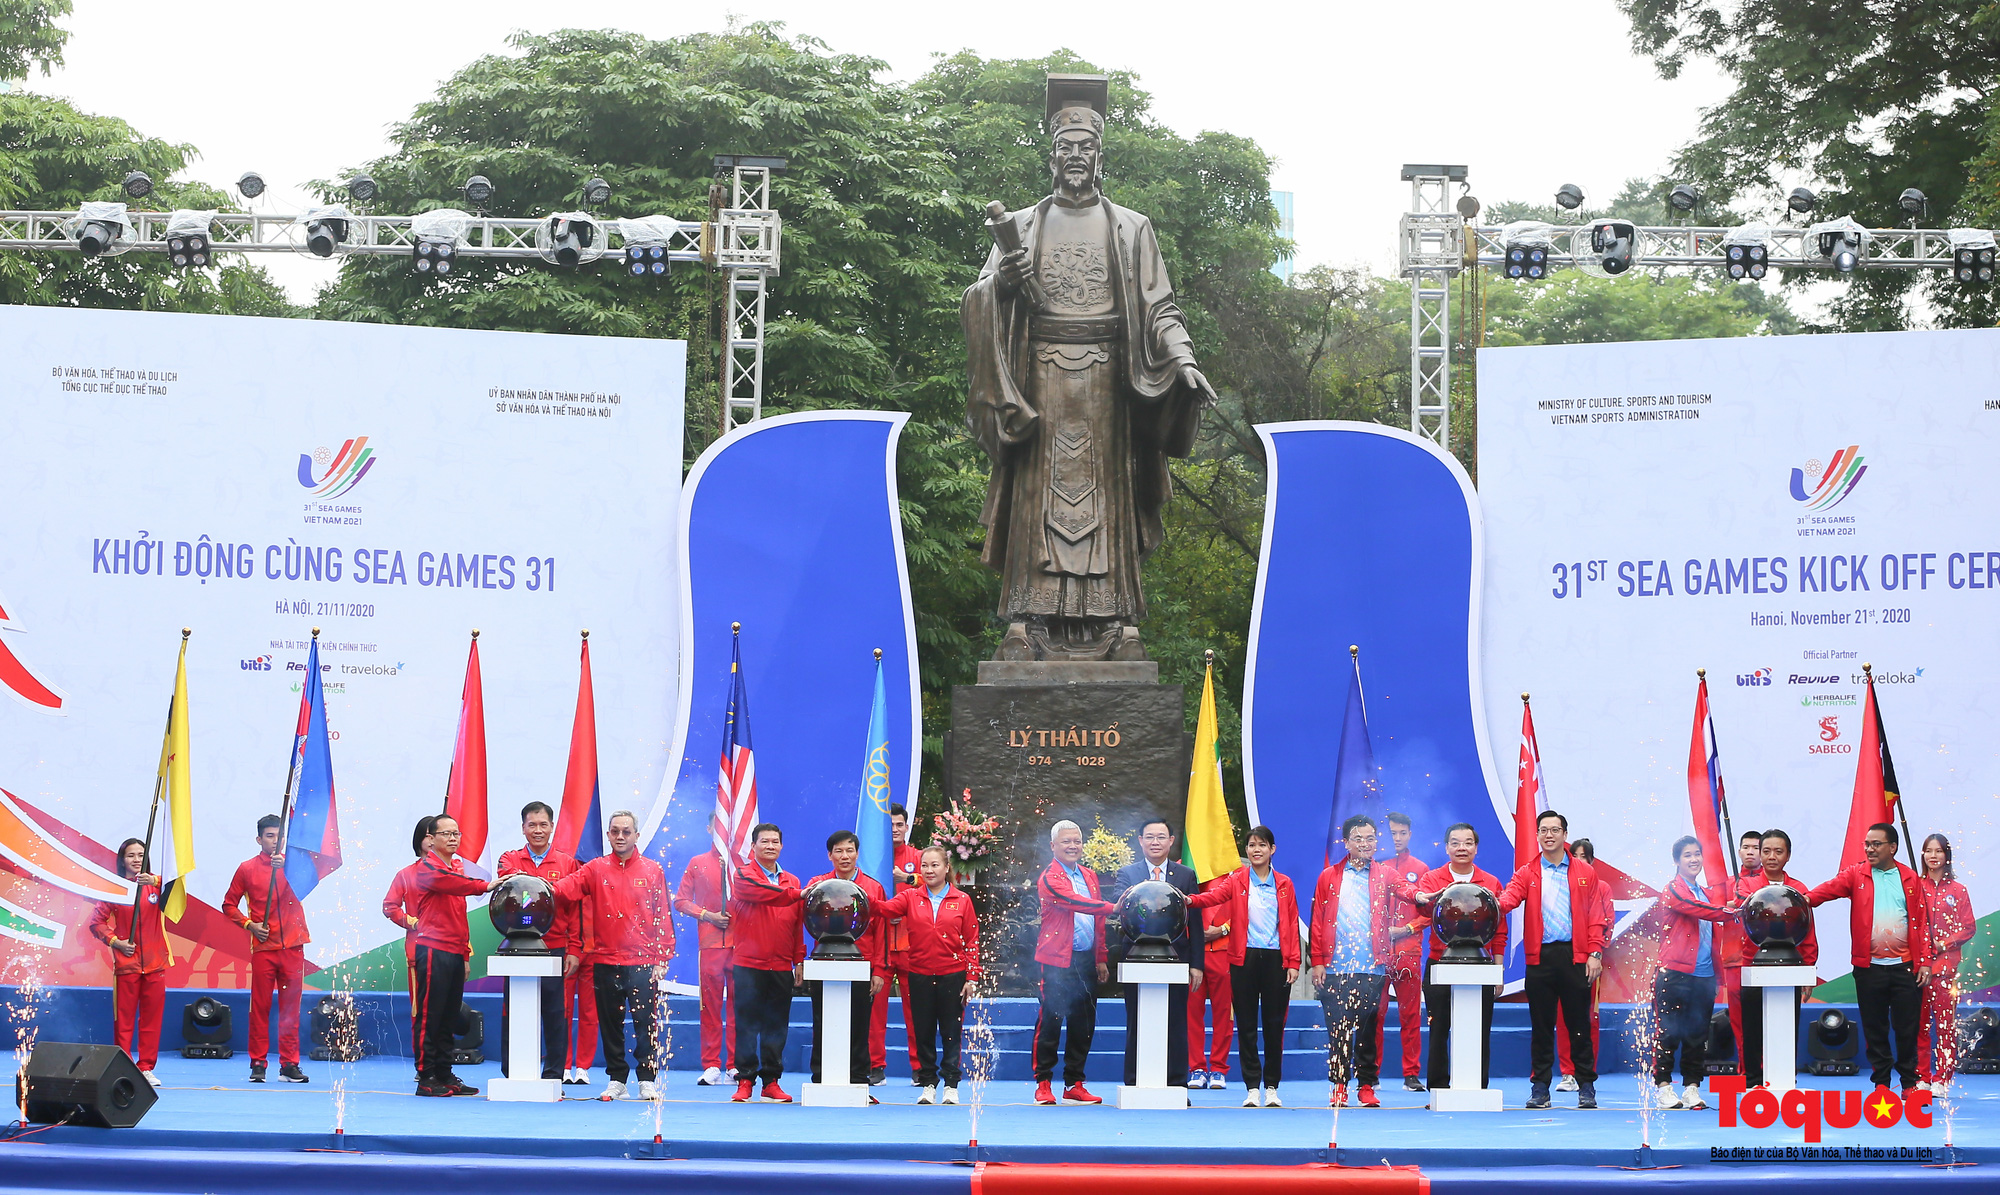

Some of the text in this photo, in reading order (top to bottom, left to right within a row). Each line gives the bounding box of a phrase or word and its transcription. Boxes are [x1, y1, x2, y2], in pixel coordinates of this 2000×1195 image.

[52, 365, 62, 379] BỘ
[64, 366, 79, 377] VĂN
[116, 370, 135, 380] THAO
[137, 369, 146, 380] VÀ
[148, 371, 158, 381] DU
[160, 372, 177, 383] LỊCH
[83, 383, 98, 394] CỤC
[115, 384, 130, 396] DỤC
[148, 385, 167, 395] THAO
[488, 386, 621, 406] UỶ BAN NHÂN DÂN THÀNH PHỐ HÀ NỘI
[1538, 394, 1712, 410] MINISTRY OF CULTURE, SPORTS AND TOURISM
[496, 401, 507, 412] SỞ
[508, 402, 523, 413] VĂN
[525, 403, 539, 414] HÓA
[542, 404, 550, 414] VÀ
[567, 407, 586, 416] THAO
[587, 406, 597, 417] HÀ
[599, 407, 611, 419] NỘI
[1551, 409, 1699, 425] VIETNAM SPORTS ADMINISTRATION
[335, 505, 362, 513] GAMES
[344, 517, 362, 525] 2021
[1816, 528, 1835, 536] NAM
[1837, 528, 1856, 536] 2021
[93, 530, 555, 591] KHỞI ĐỘNG CÙNG SEA GAMES 31
[1552, 552, 2000, 599] 31ST SEA GAMES KICK OFF CER
[276, 598, 289, 614] HÀ
[317, 603, 374, 617] 21/11/2020
[1750, 611, 1787, 627] Hanoi,
[1791, 609, 1851, 625] November
[1882, 608, 1911, 624] 2020
[270, 639, 283, 649] NHÀ
[285, 639, 294, 649] TÀI
[322, 641, 337, 652] KIỆN
[339, 641, 358, 651] CHÍNH
[360, 642, 377, 652] THỨC
[1803, 650, 1858, 659] Official Partner
[341, 664, 397, 676] traveloka
[1788, 674, 1840, 684] Revive
[1010, 721, 1121, 747] LÝ THÁI TỔ
[1809, 744, 1851, 754] SABECO
[1028, 756, 1052, 766] 974
[1076, 756, 1106, 766] 1028
